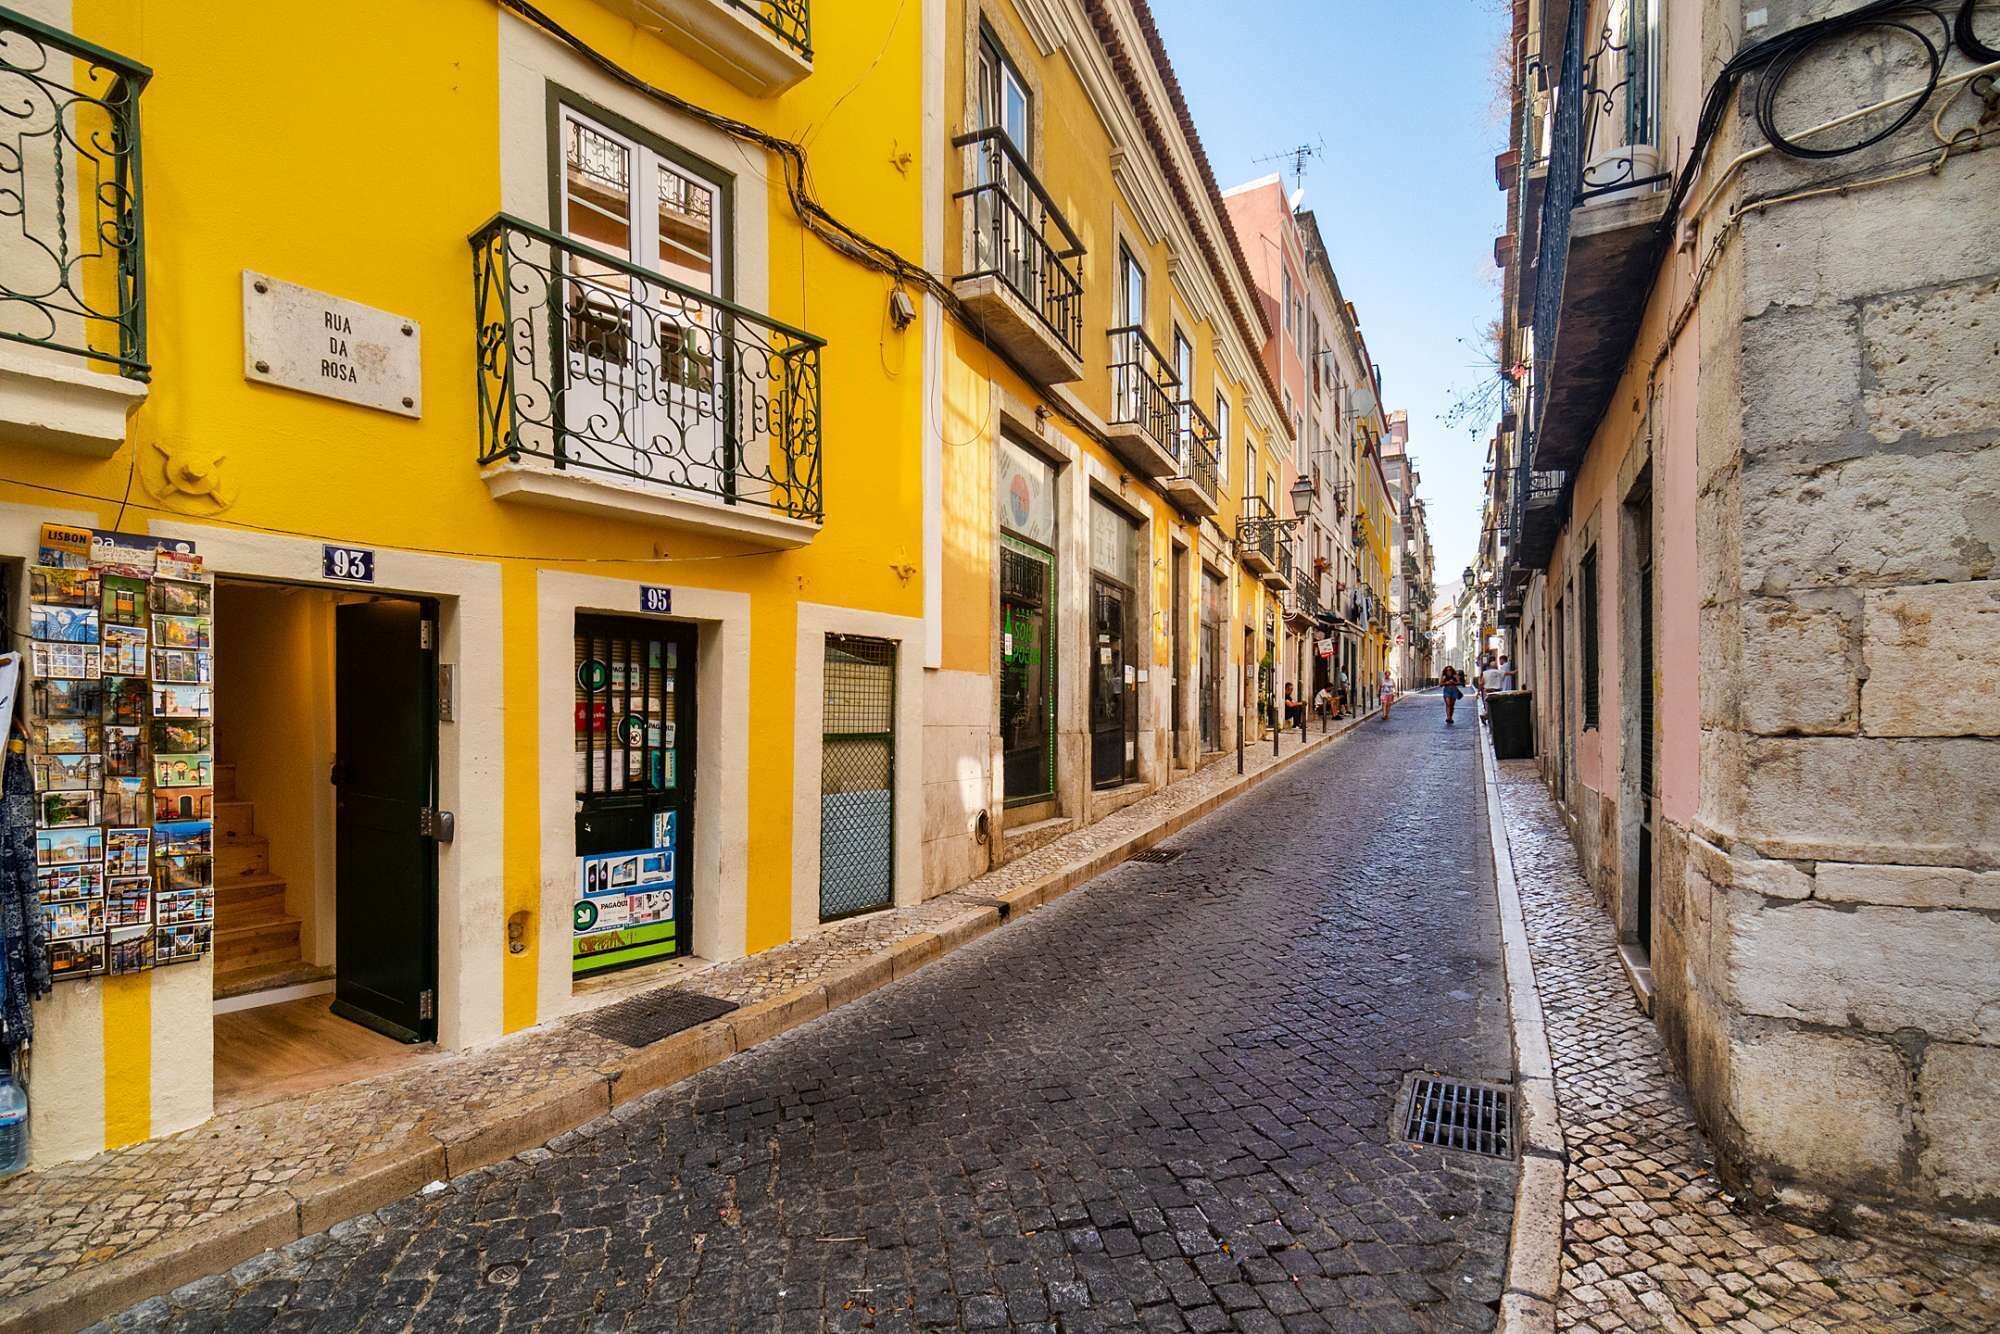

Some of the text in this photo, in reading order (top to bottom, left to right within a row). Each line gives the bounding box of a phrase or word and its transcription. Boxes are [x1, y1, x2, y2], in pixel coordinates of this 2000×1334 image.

[324, 311, 352, 335] RUA
[329, 336, 348, 357] DA
[321, 359, 357, 384] ROSA
[47, 529, 87, 545] LISBON
[334, 549, 365, 578] 93
[647, 588, 667, 611] 95
[600, 900, 628, 910] PAGAQUI
